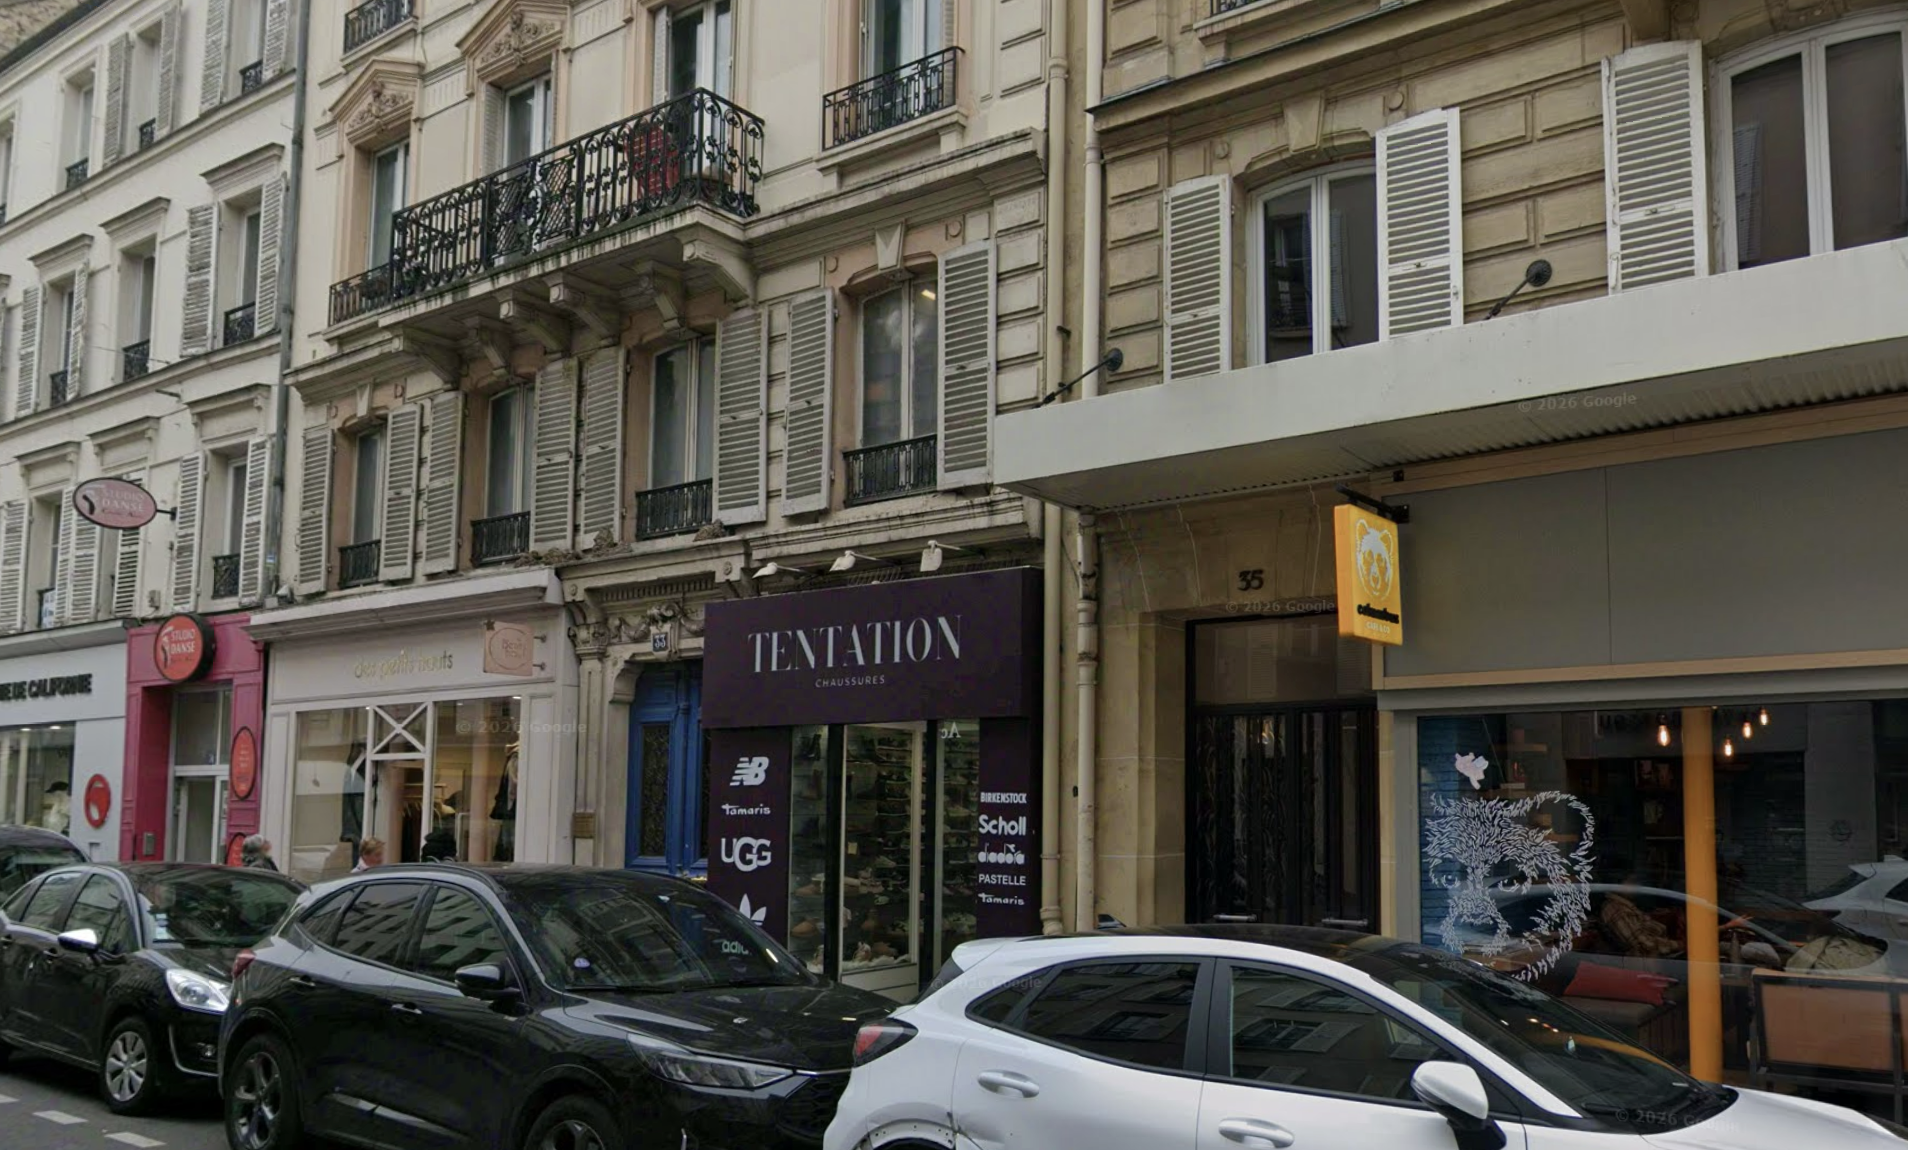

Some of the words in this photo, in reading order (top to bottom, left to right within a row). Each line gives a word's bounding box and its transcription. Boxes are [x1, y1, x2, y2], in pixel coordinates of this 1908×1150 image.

[102, 498, 145, 512] DANSE
[1237, 569, 1265, 592] 35
[171, 629, 196, 641] STUDIO
[654, 634, 666, 648] 33
[171, 641, 196, 655] DANSE
[748, 614, 963, 673] TENTATION
[815, 674, 886, 688] CHAUSSURES
[980, 791, 1027, 804] BIRKENSTOCK
[721, 803, 771, 816] Tamaris
[978, 814, 1027, 836] Scholl
[721, 836, 772, 872] UGG
[978, 873, 1027, 886] PASTELLE
[978, 892, 1025, 906] Tamaris
